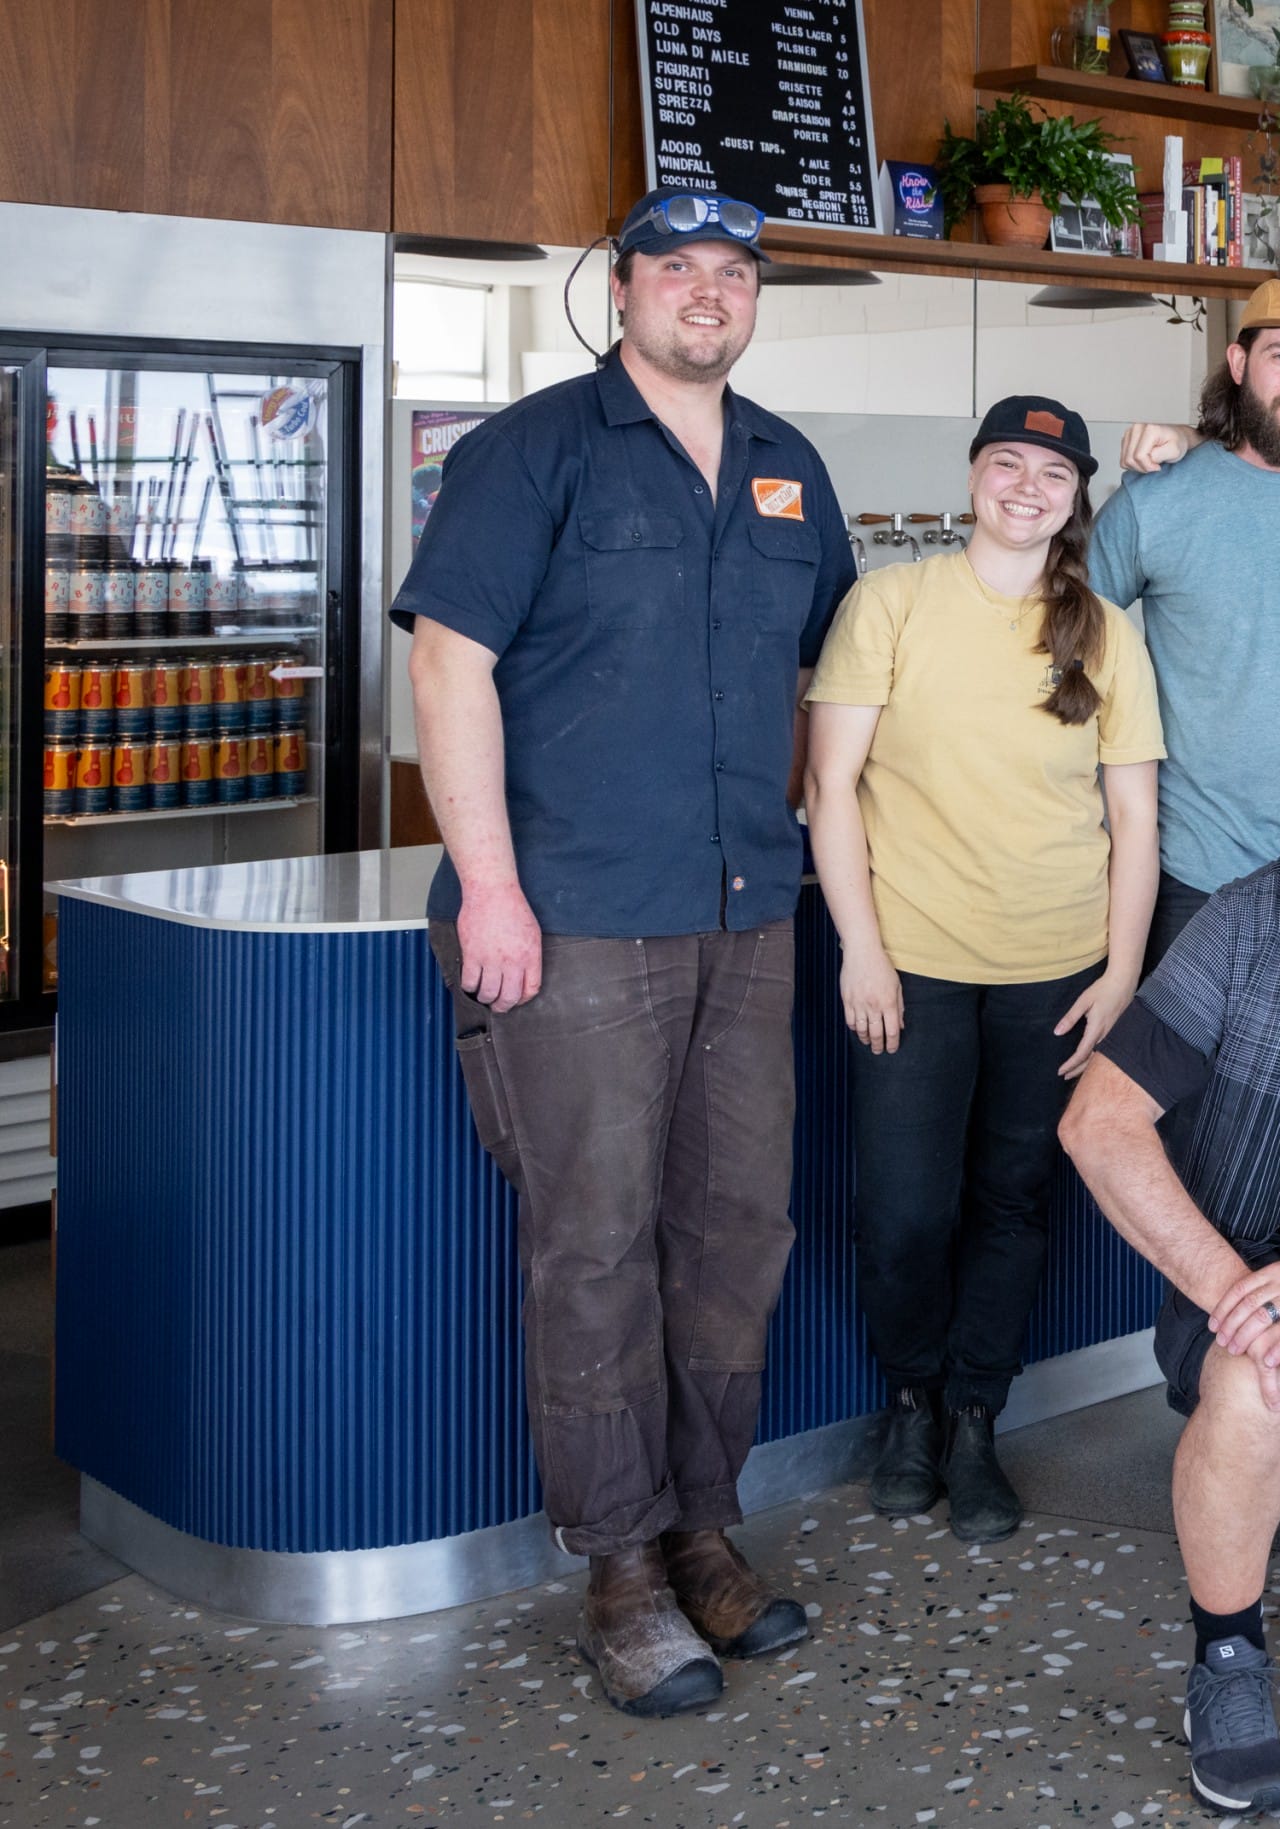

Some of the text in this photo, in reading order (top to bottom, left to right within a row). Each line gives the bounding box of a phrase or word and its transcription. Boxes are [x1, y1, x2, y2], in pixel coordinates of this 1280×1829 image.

[651, 2, 713, 23] ALPENHAUS
[784, 6, 839, 26] VIENNA 5
[654, 21, 721, 43] OLD DAYS
[771, 22, 847, 44] HELLES LAGER 5
[656, 40, 750, 66] LUNA DI MIELE
[777, 41, 817, 57] PILSNER
[656, 61, 710, 81] FIGURATI
[777, 59, 828, 77] FARMHOUSE
[655, 76, 712, 97] SUPERIO
[778, 81, 823, 97] GRISETTE
[658, 93, 712, 113] SPREZZA
[788, 96, 821, 110] SAISON
[659, 109, 696, 126] BRICO
[772, 110, 799, 124] GRAPE
[800, 114, 831, 127] SAISON
[793, 129, 828, 143] PORTER
[661, 139, 702, 156] ADORO
[658, 155, 714, 174] WINDFALL
[809, 159, 831, 170] MILE
[661, 175, 717, 190] COCKTAILS
[802, 174, 831, 187] CIDER
[902, 175, 928, 188] Know
[802, 199, 841, 212] NEGRONI
[819, 191, 847, 203] SPRITZ
[788, 207, 804, 218] RED
[817, 211, 846, 223] WHITE
